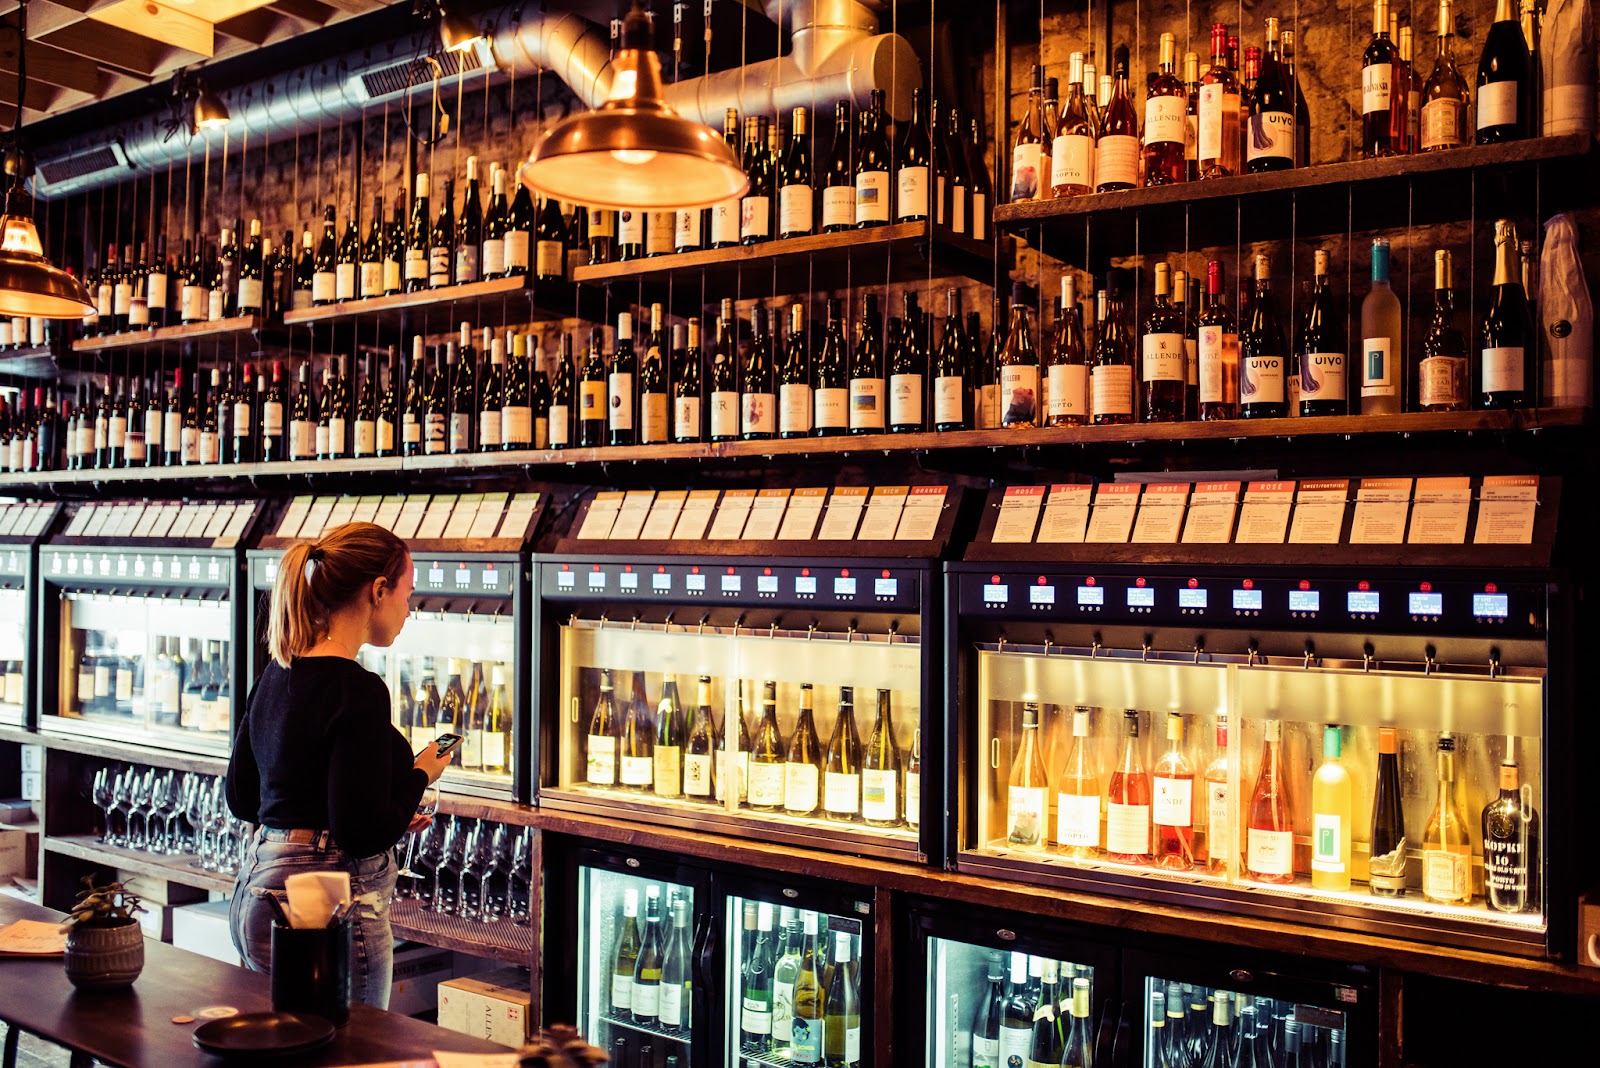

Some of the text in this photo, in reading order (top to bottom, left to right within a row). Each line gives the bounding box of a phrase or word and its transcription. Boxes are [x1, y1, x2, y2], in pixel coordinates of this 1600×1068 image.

[1147, 114, 1182, 123] ALLENDE
[1269, 115, 1293, 126] UIVO
[1146, 352, 1182, 360] ALLENDE
[1251, 360, 1279, 369] UIVO
[1315, 357, 1342, 367] UIVO
[1015, 487, 1035, 495] ROSÉ
[1109, 485, 1130, 493] ROSÉ
[1157, 484, 1178, 492] ROSÉ
[1207, 482, 1229, 491] ROSÉ
[1260, 482, 1283, 491] ROSÉ
[1484, 838, 1525, 854] KOPKE
[1495, 853, 1510, 866] 10
[485, 1004, 493, 1041] ALLEN
